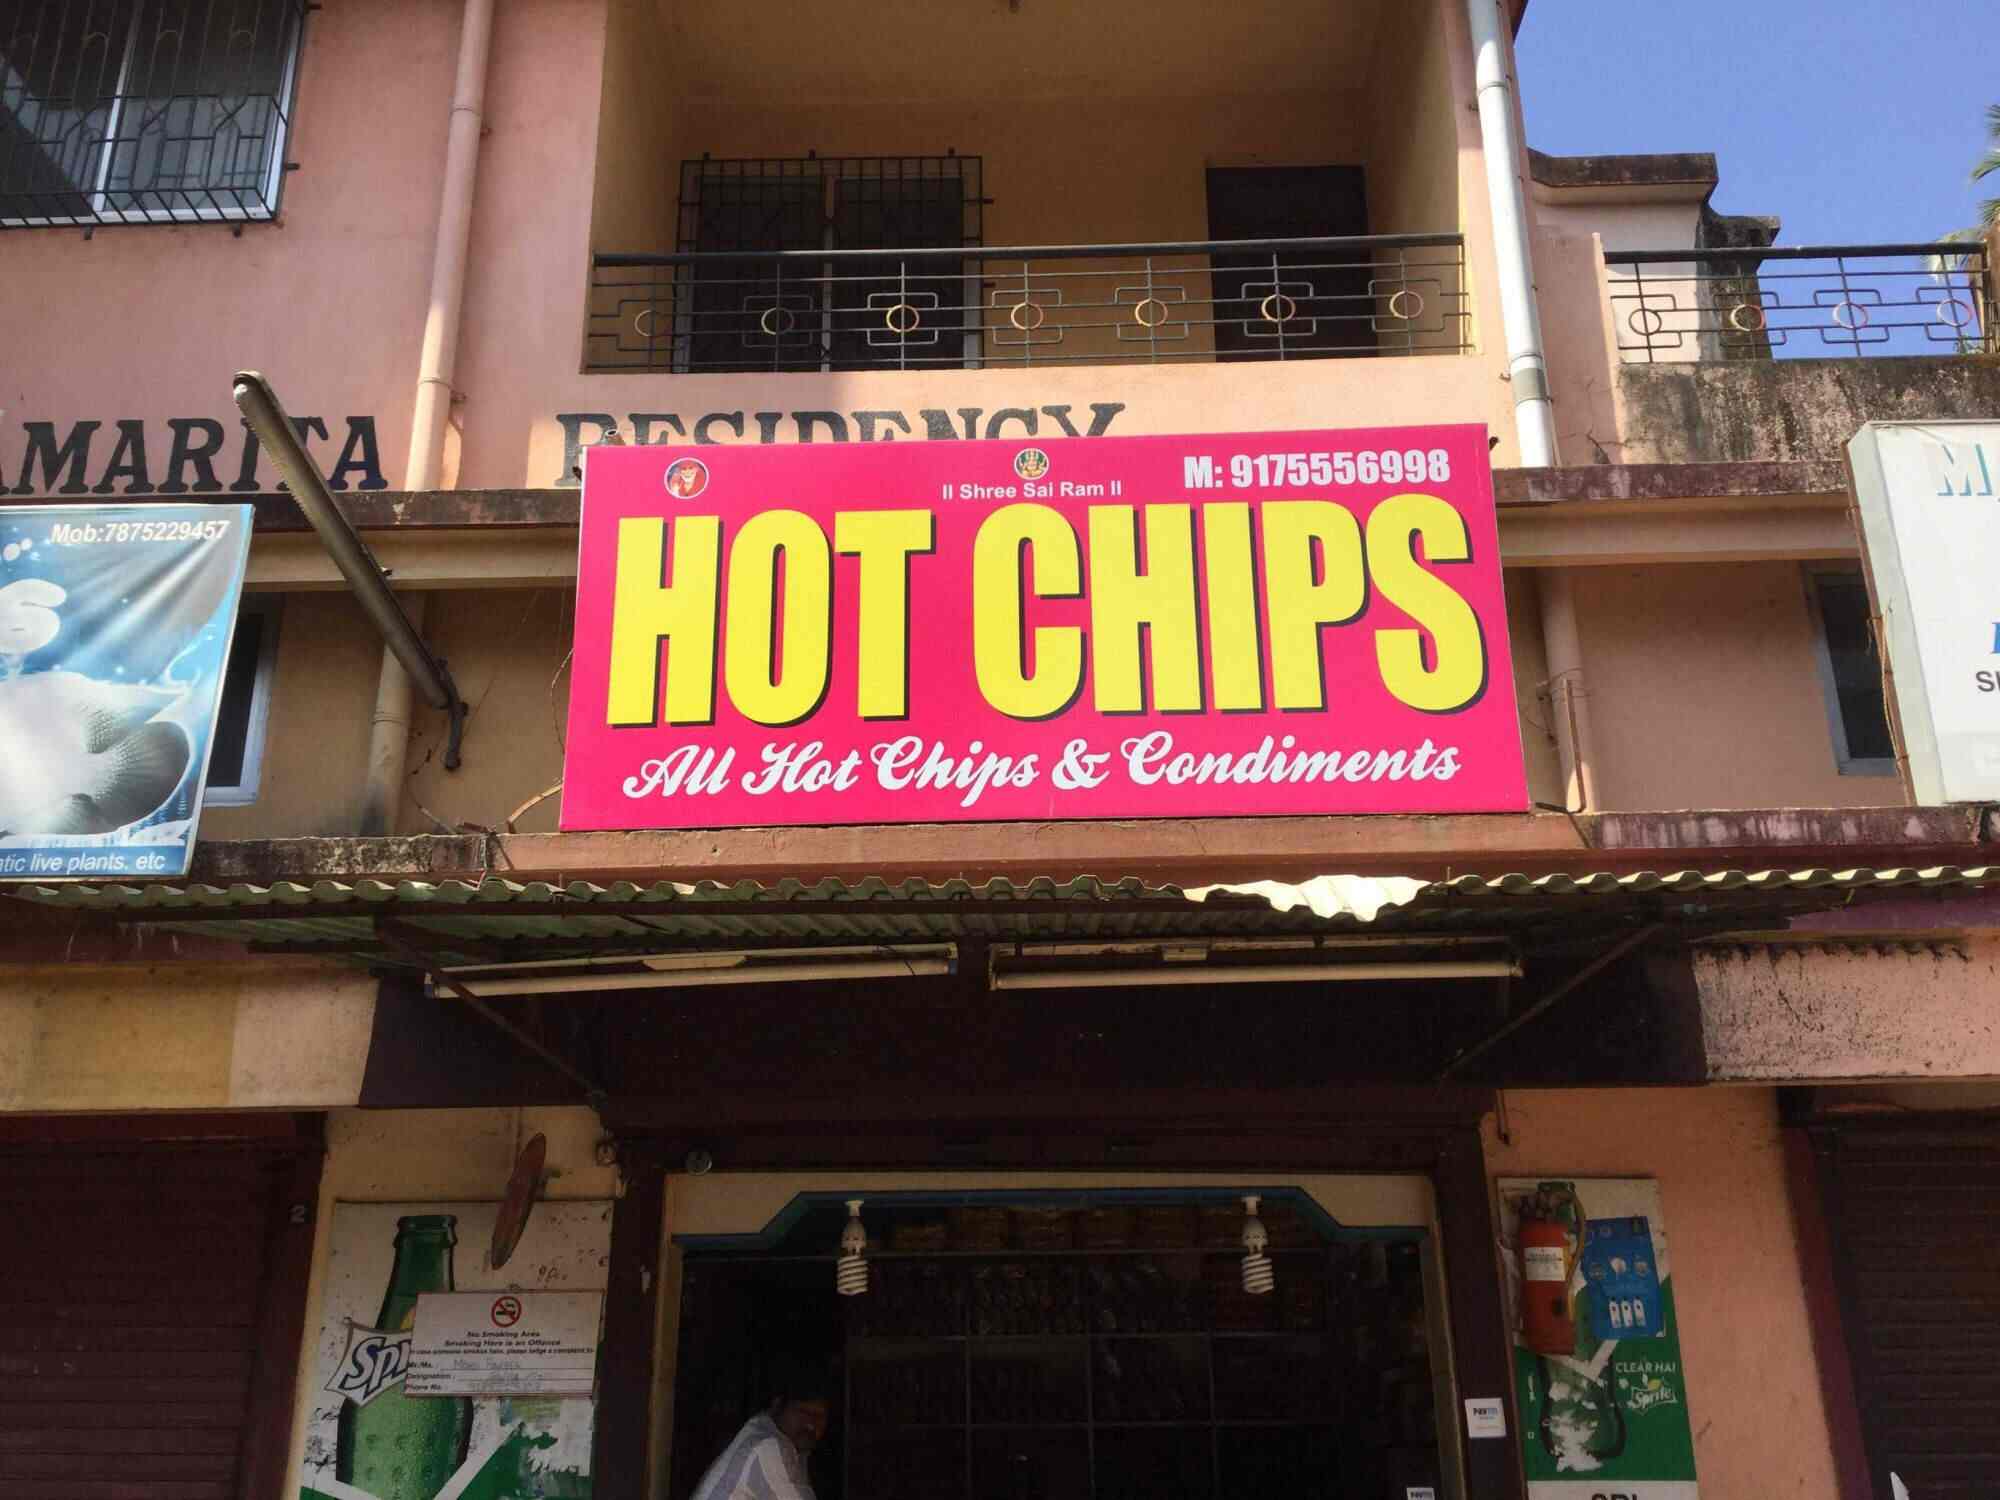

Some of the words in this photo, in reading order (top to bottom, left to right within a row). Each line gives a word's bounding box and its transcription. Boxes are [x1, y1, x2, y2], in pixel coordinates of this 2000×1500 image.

[0, 415, 389, 495] MARIA
[1230, 449, 1451, 488] 9175556998
[959, 483, 1017, 499] Shree
[1023, 482, 1054, 498] Sai
[1060, 481, 1105, 497] Ram
[50, 520, 232, 544] Mob:7875229457
[607, 506, 936, 729] HOT
[972, 493, 1489, 724] CHIPS
[622, 744, 736, 799] All
[741, 740, 863, 796] Hot
[869, 735, 1040, 808] Chips
[1051, 738, 1111, 790] &
[1120, 730, 1462, 786] Condiments
[29, 852, 63, 873] live
[135, 850, 166, 871] etc
[1615, 1360, 1653, 1374] CLEAR
[1655, 1360, 1677, 1374] HAI
